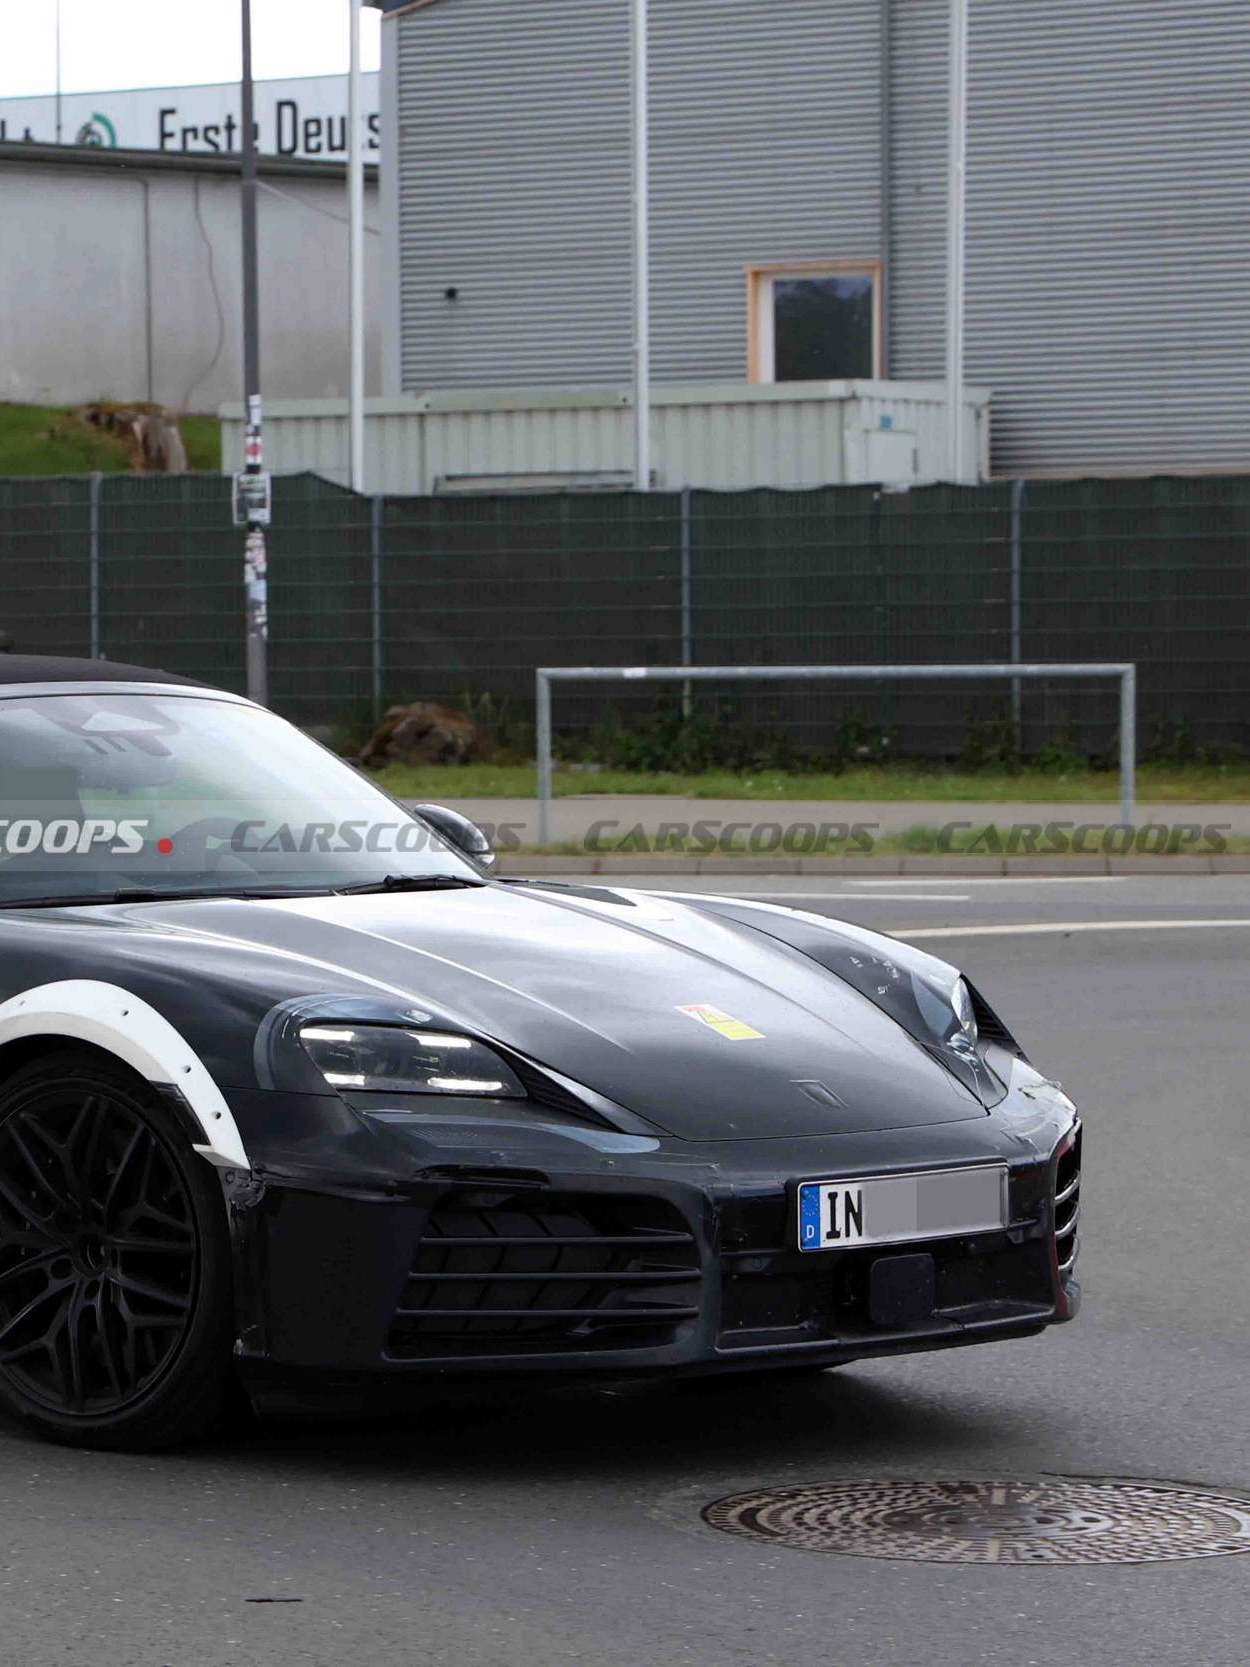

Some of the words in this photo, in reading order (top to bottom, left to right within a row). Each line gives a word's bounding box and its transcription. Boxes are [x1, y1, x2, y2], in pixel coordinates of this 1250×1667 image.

[276, 100, 379, 153] Deus
[805, 1224, 815, 1239] D
[825, 1189, 863, 1240] IN
